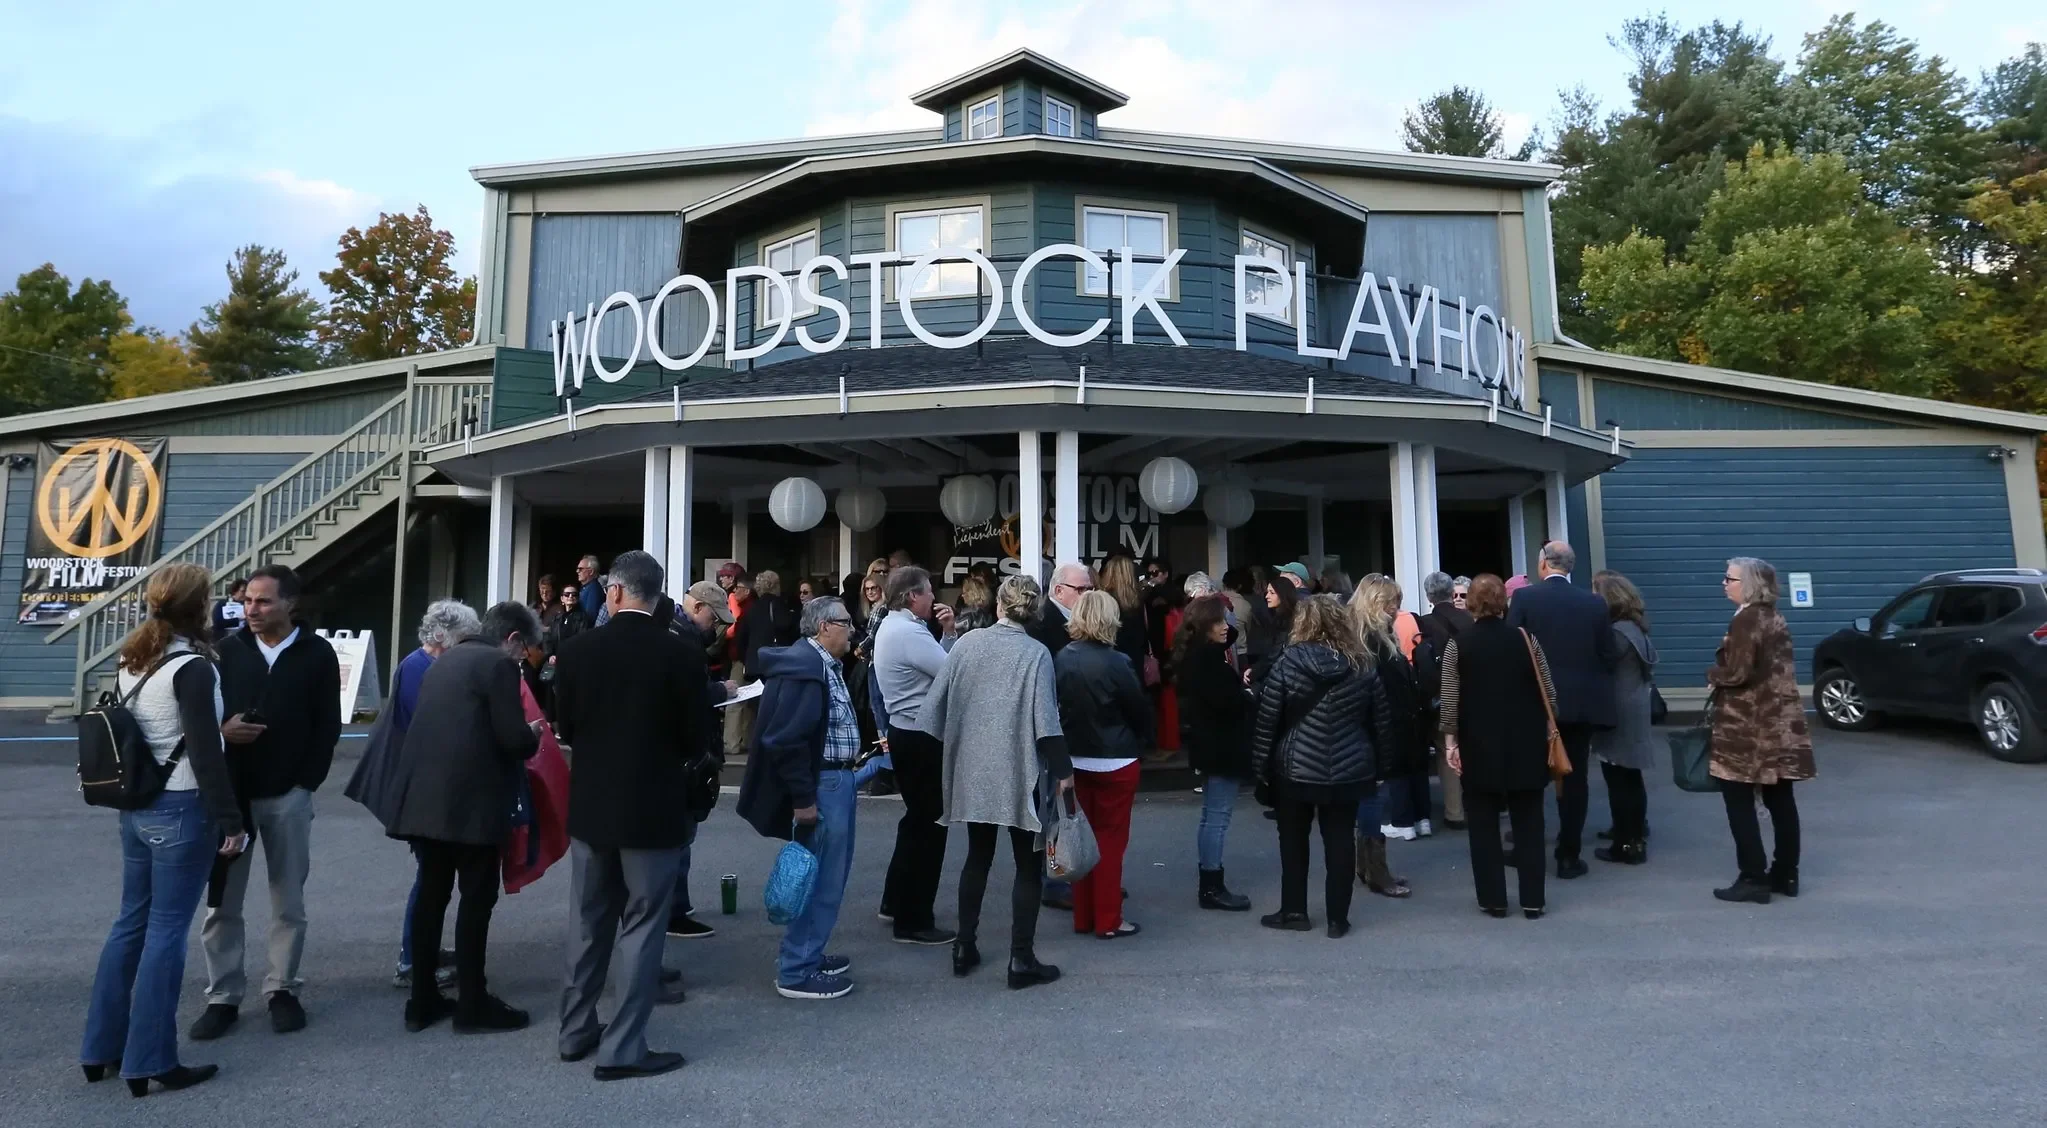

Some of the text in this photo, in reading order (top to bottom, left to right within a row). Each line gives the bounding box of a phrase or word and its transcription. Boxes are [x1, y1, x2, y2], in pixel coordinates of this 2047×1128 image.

[551, 243, 1525, 410] WOODSTOCK PLAYHOUS
[27, 557, 105, 569] WOODSTOCK
[48, 566, 148, 588] FILM FESTIV
